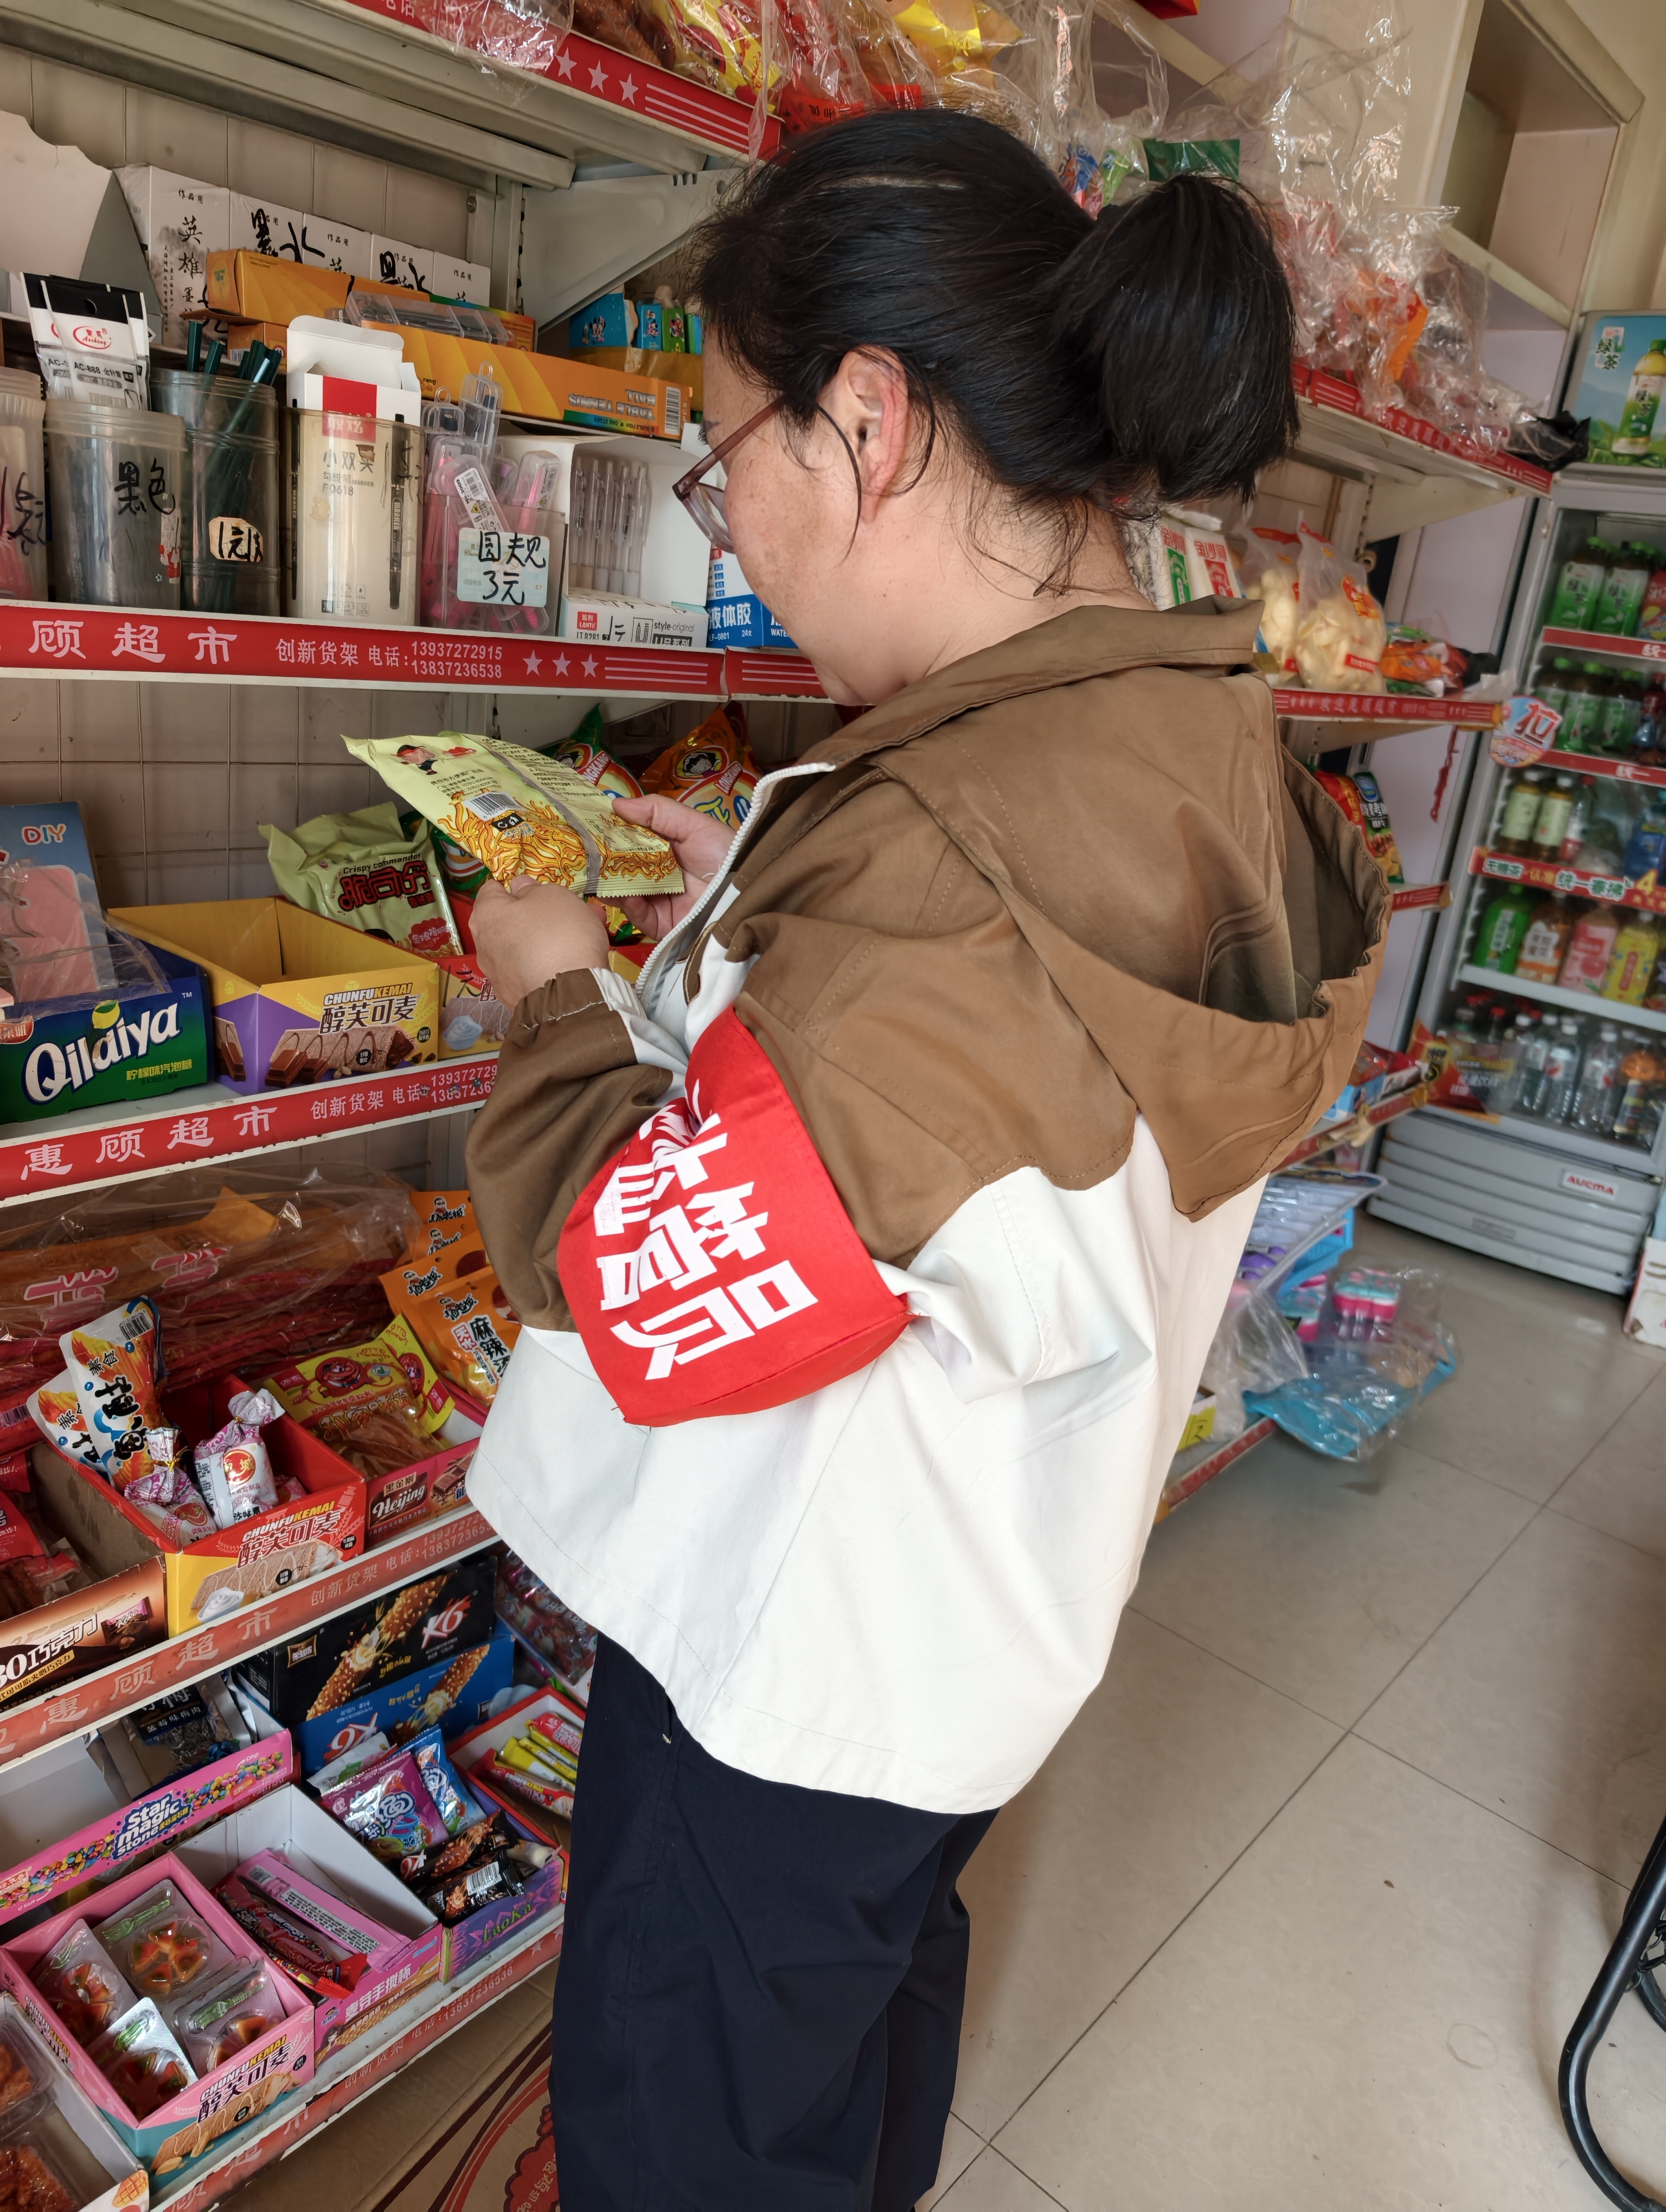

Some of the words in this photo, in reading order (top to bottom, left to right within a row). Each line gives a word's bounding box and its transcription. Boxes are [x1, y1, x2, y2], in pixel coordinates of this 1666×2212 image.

[178, 189, 203, 204] 作品用
[327, 233, 349, 247] 作品用
[178, 215, 203, 321] 英雄墨
[74, 362, 101, 375] AC-888
[616, 402, 656, 421] TABLE
[625, 389, 656, 406] BALL
[114, 458, 176, 515] 黑色
[478, 530, 546, 569] 圆规
[483, 570, 525, 606] 3元
[275, 638, 359, 666] 创新货架
[411, 641, 503, 660] 13937272915
[412, 661, 502, 679] 13837236538
[22, 823, 66, 845] DIY
[343, 864, 371, 874] Crispy
[323, 982, 413, 1006] CHUNFUKEMAI
[319, 995, 419, 1035] 醇芙可麦
[25, 1002, 180, 1103] Qilaiya
[311, 1090, 384, 1120] 创新货架
[21, 1105, 278, 1181] 惠顾超市
[1566, 1175, 1615, 1196] AUCMA
[454, 1325, 477, 1351] 天水
[86, 1348, 119, 1376] 素食
[385, 1475, 415, 1494] 黑金刚
[372, 1484, 427, 1518] Heijing
[242, 1500, 336, 1542] CHUNFUKEMAI
[236, 1507, 345, 1569] 醇芙可麦
[310, 1562, 379, 1605] 创新货架
[421, 1598, 464, 1650] K6
[41, 1607, 279, 1725] 惠顾超市
[117, 1801, 180, 1848] magic
[127, 1793, 170, 1829] Star
[117, 1826, 159, 1856] stone
[197, 2041, 293, 2124] 醇芙可麦
[200, 2034, 287, 2102] CHUNFUKEMAI
